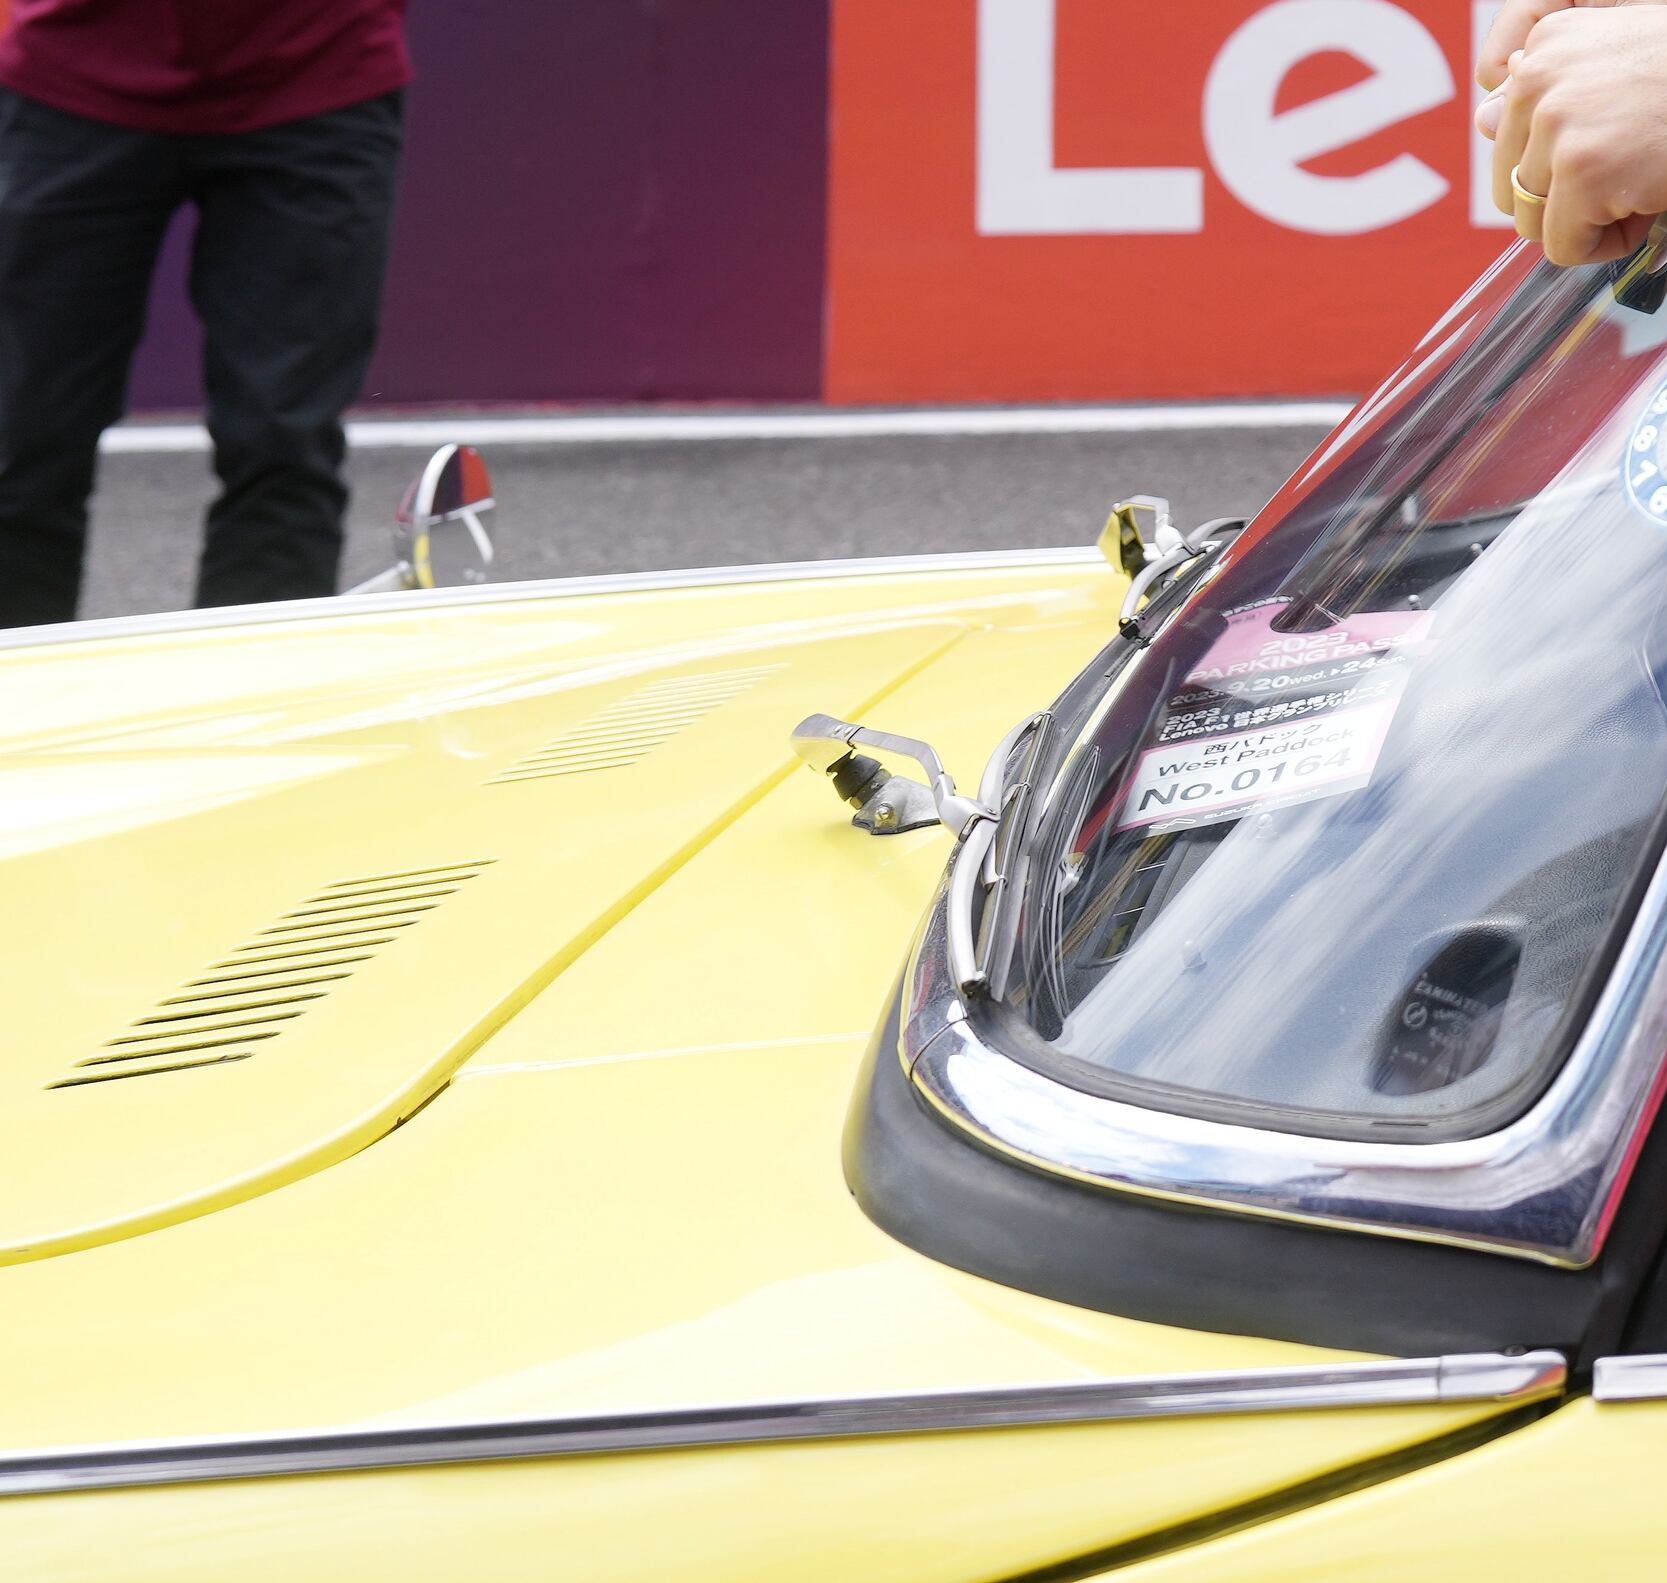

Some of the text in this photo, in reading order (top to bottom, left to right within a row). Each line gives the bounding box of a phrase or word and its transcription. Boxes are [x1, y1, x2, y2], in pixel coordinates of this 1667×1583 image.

[1184, 635, 1410, 684] PARKING PASS
[1261, 631, 1348, 657] 2023
[1159, 723, 1229, 742] Lenovo
[1166, 707, 1221, 725] 2023
[1158, 728, 1356, 777] West Paddock
[1138, 747, 1352, 812] No.0164
